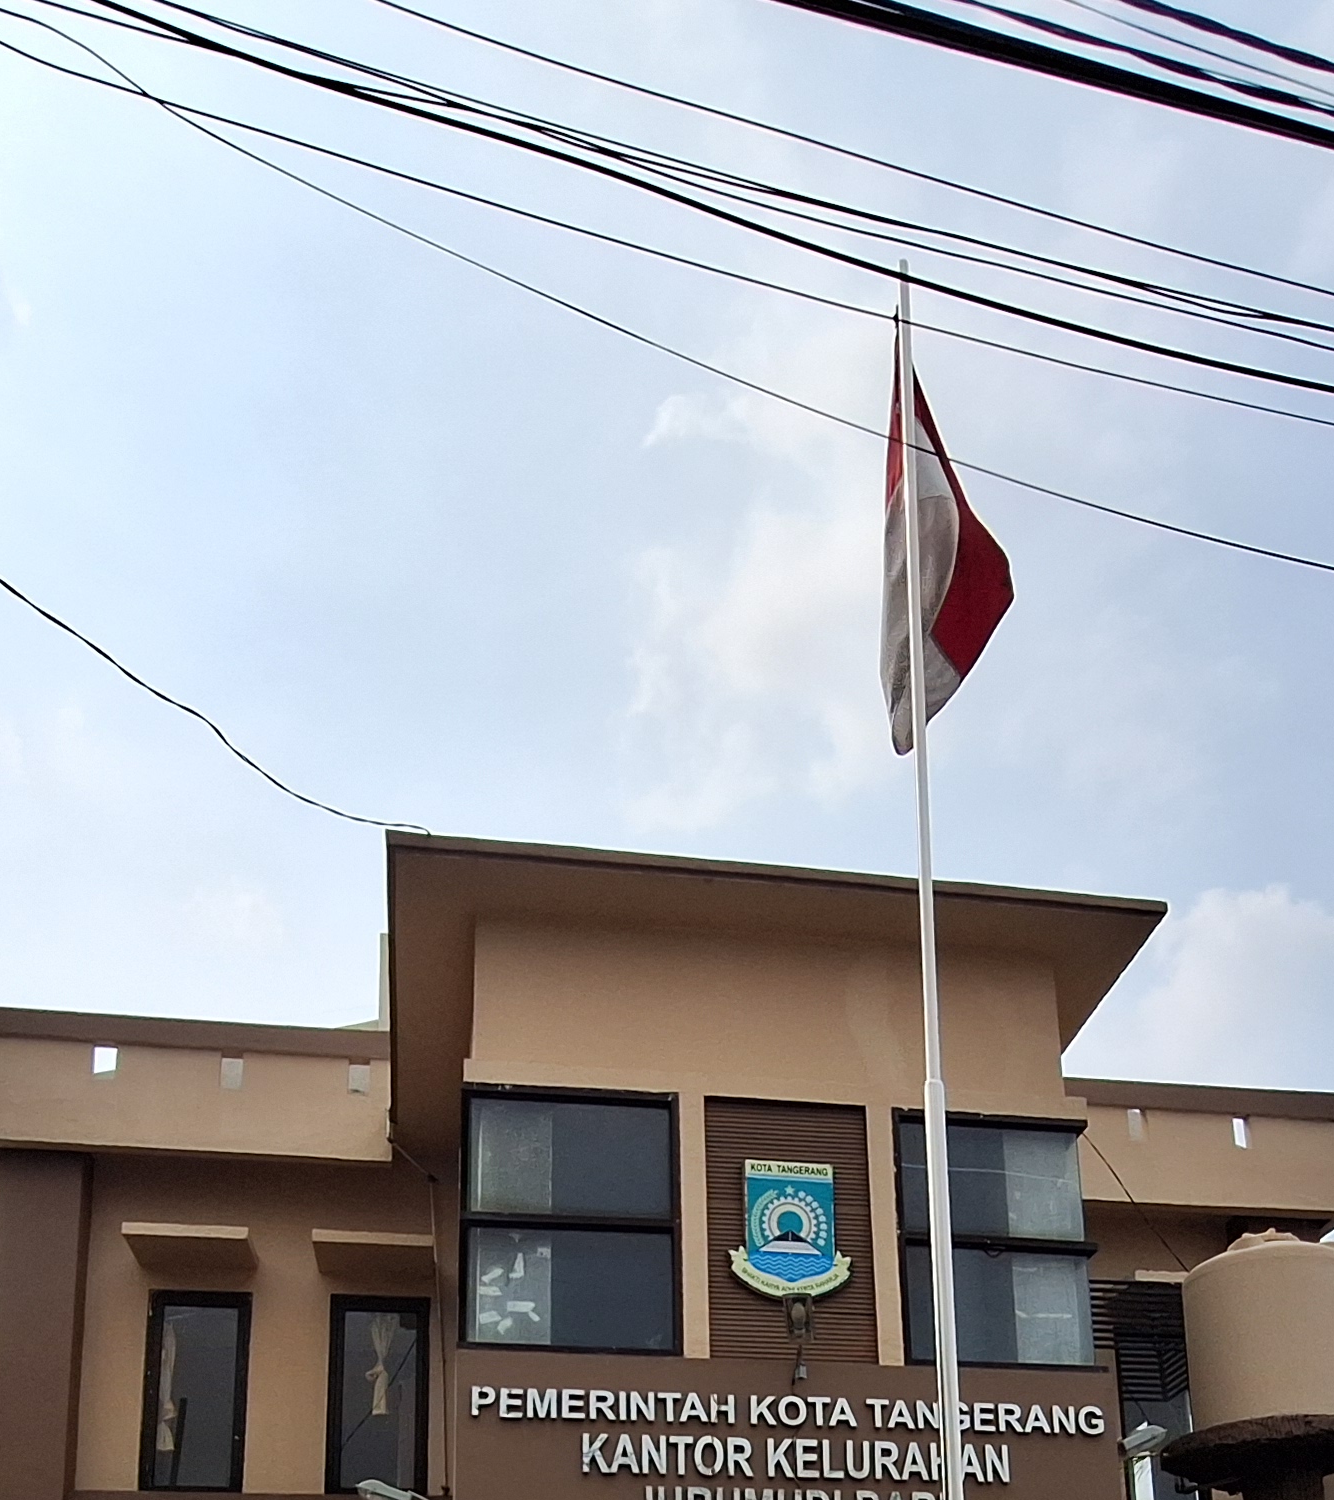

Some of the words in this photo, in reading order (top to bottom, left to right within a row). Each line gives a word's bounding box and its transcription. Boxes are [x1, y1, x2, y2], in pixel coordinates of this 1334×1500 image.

[751, 1163, 773, 1173] KOTA
[776, 1164, 828, 1177] TANGERANG
[471, 1386, 735, 1425] PEMERINTAH
[749, 1395, 857, 1428] KOTA
[582, 1433, 752, 1477] KANTOR
